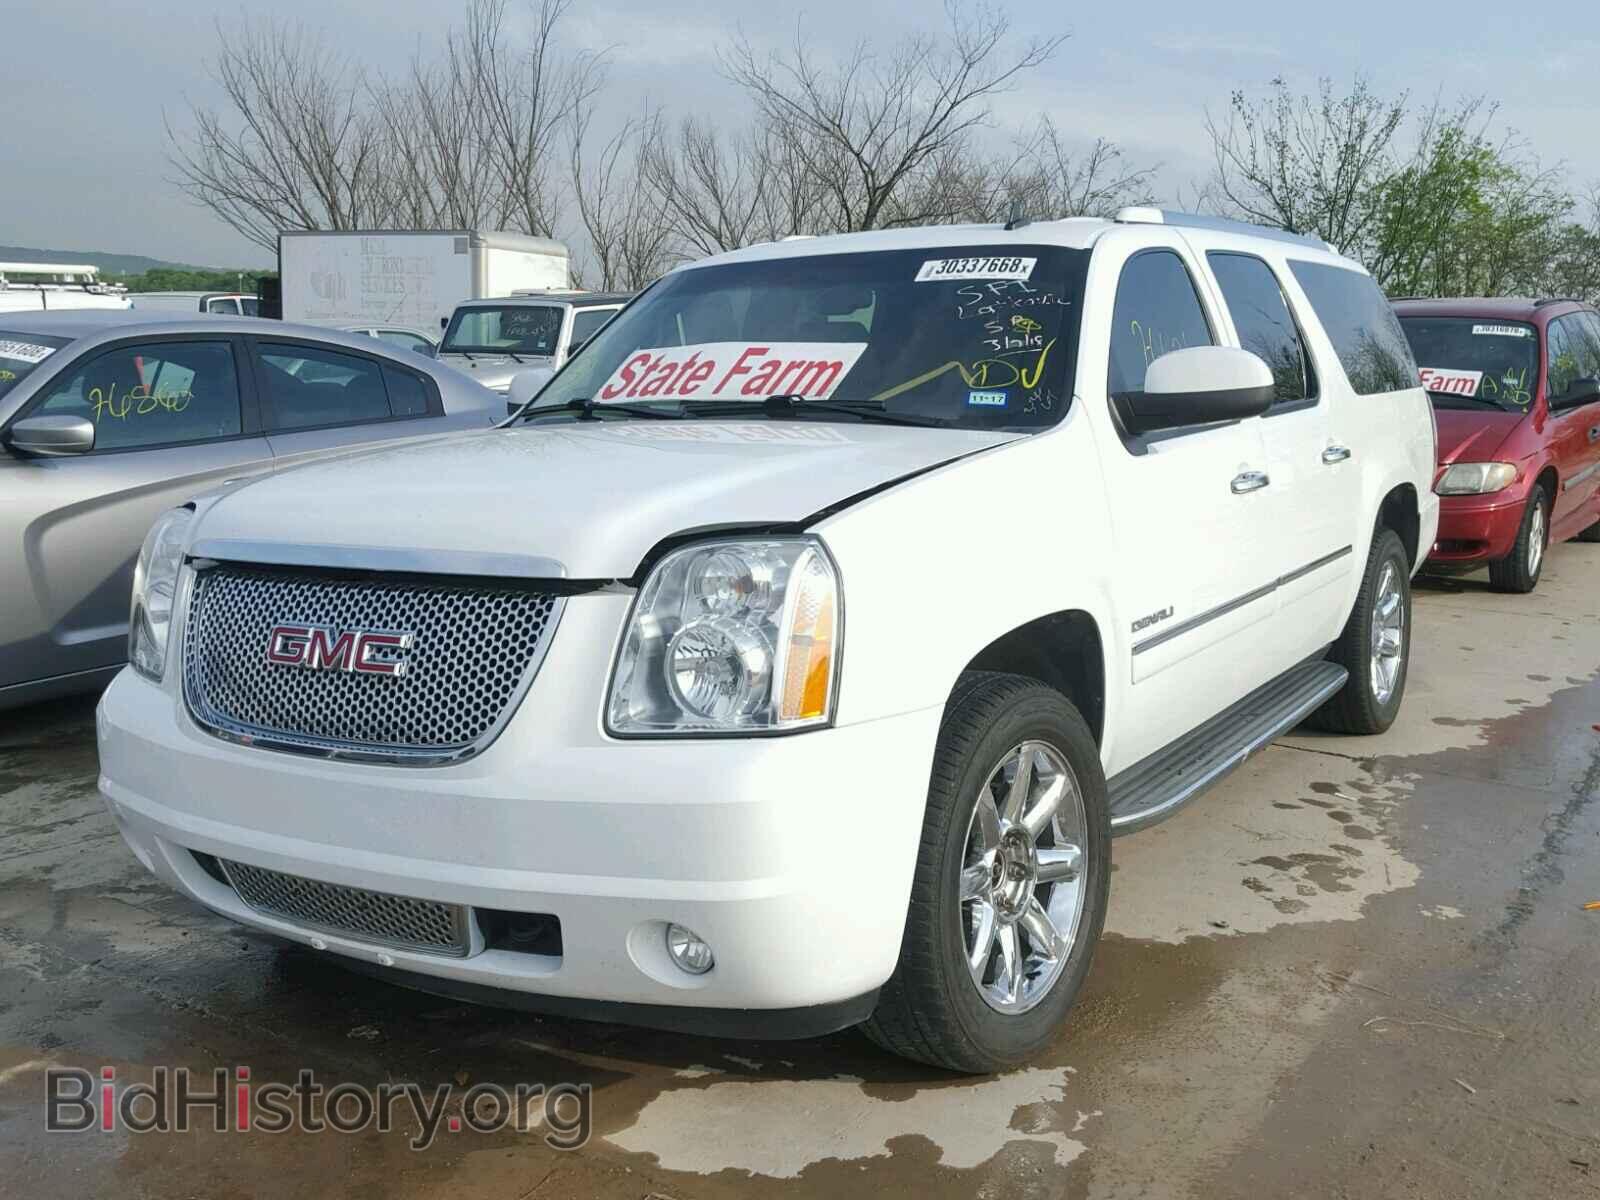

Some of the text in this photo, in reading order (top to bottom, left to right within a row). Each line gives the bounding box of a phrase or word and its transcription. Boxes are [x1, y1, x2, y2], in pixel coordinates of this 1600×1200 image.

[601, 347, 844, 400] State Farm
[1418, 369, 1476, 395] Farm
[1131, 605, 1174, 633] DENALI
[268, 625, 410, 676] GMC
